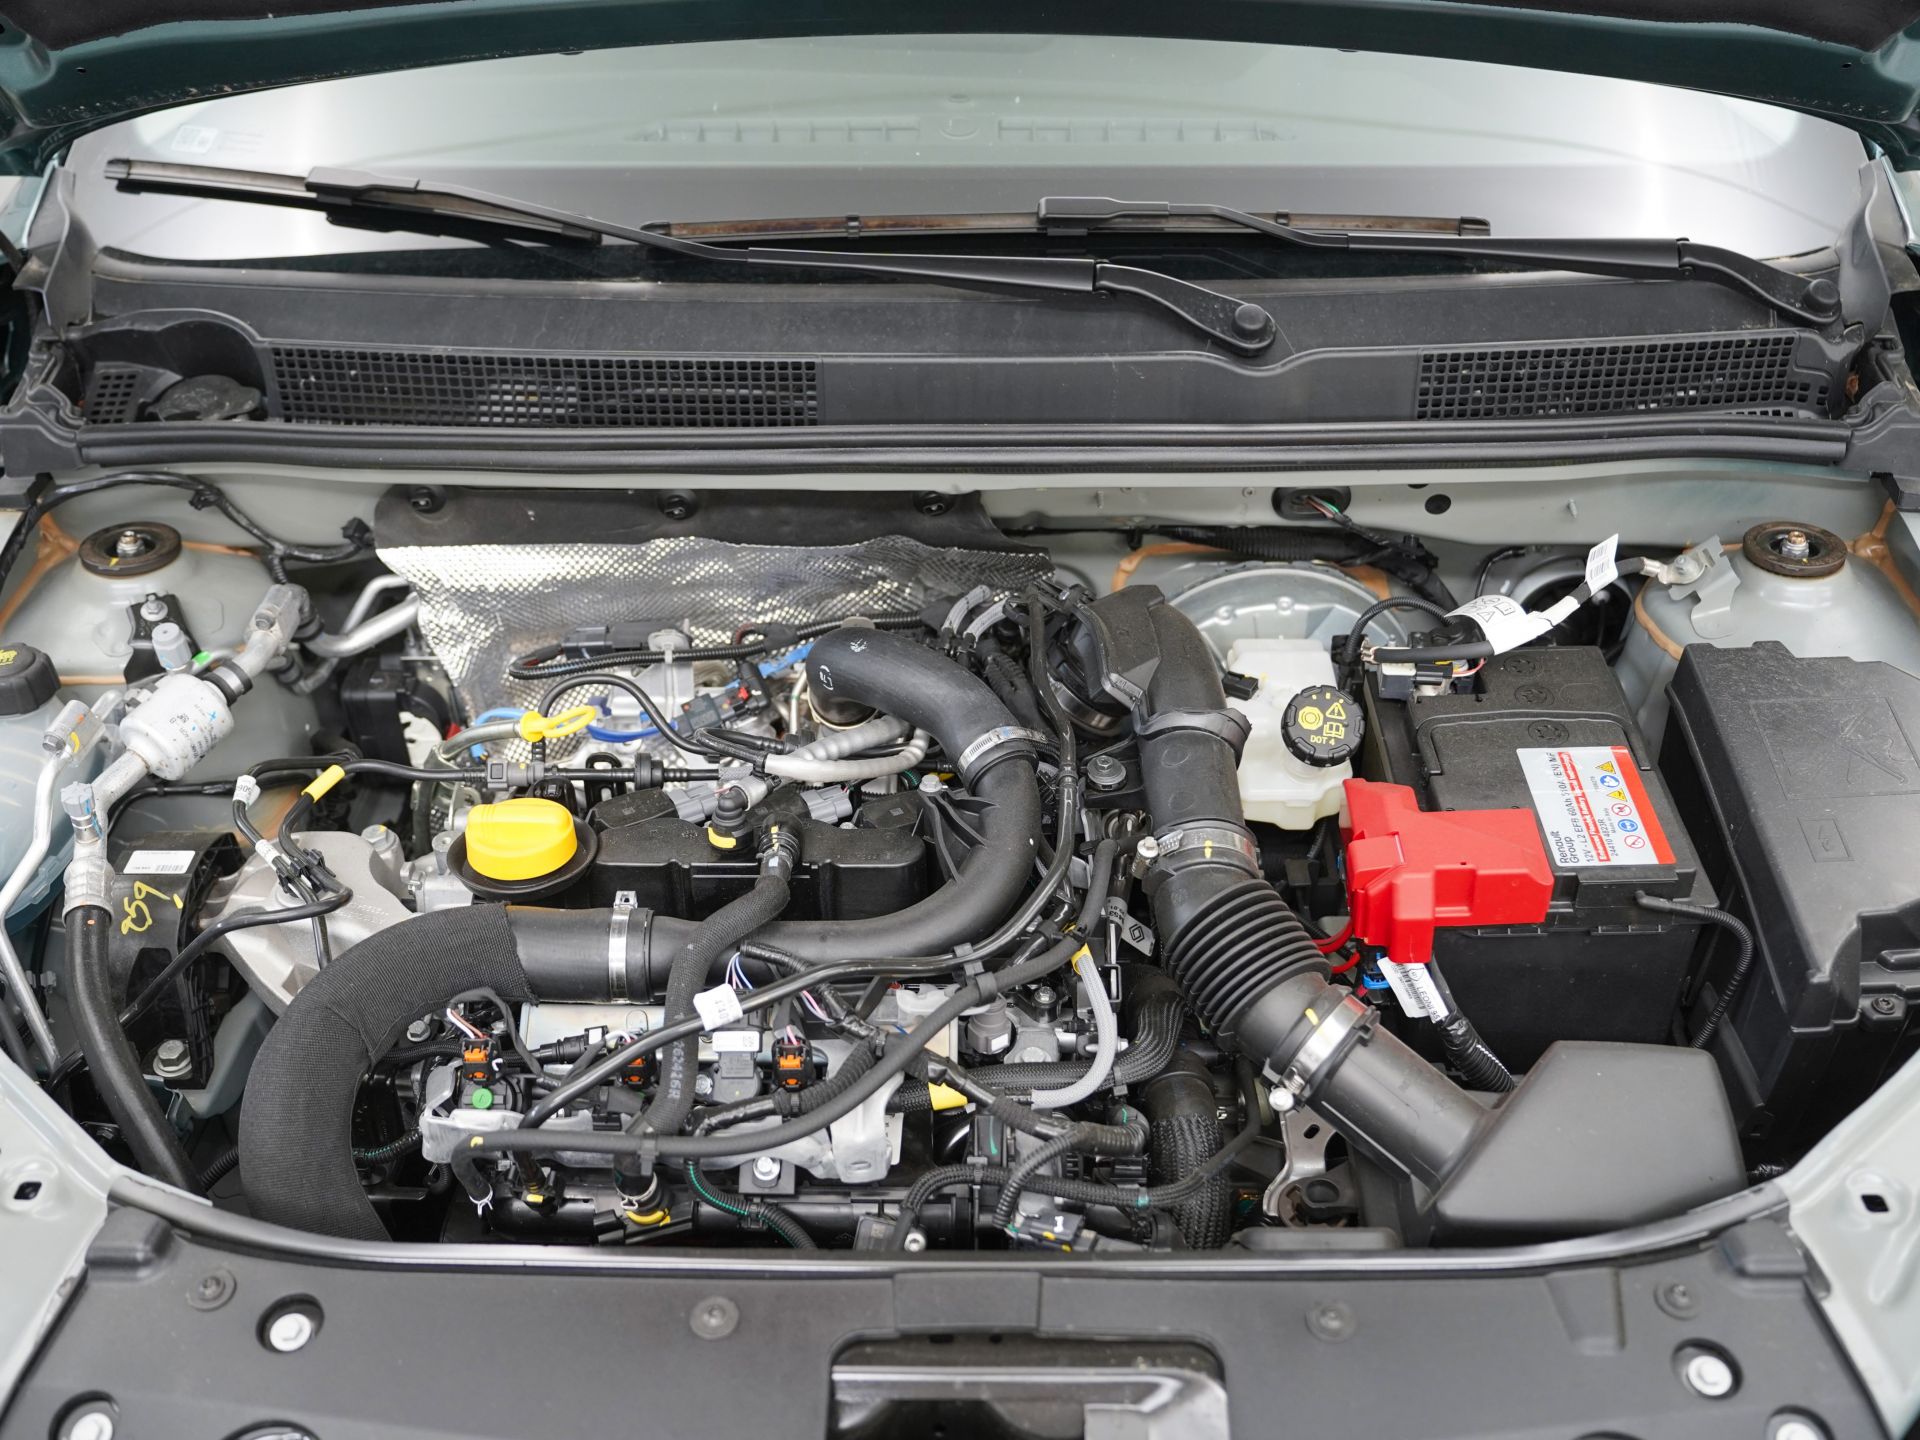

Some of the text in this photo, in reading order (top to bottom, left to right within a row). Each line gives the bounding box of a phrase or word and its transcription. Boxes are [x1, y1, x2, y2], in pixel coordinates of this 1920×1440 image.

[1310, 735, 1328, 745] DOT
[1550, 831, 1571, 864] Renault
[1564, 836, 1580, 864] Group
[1582, 849, 1594, 862] 12V
